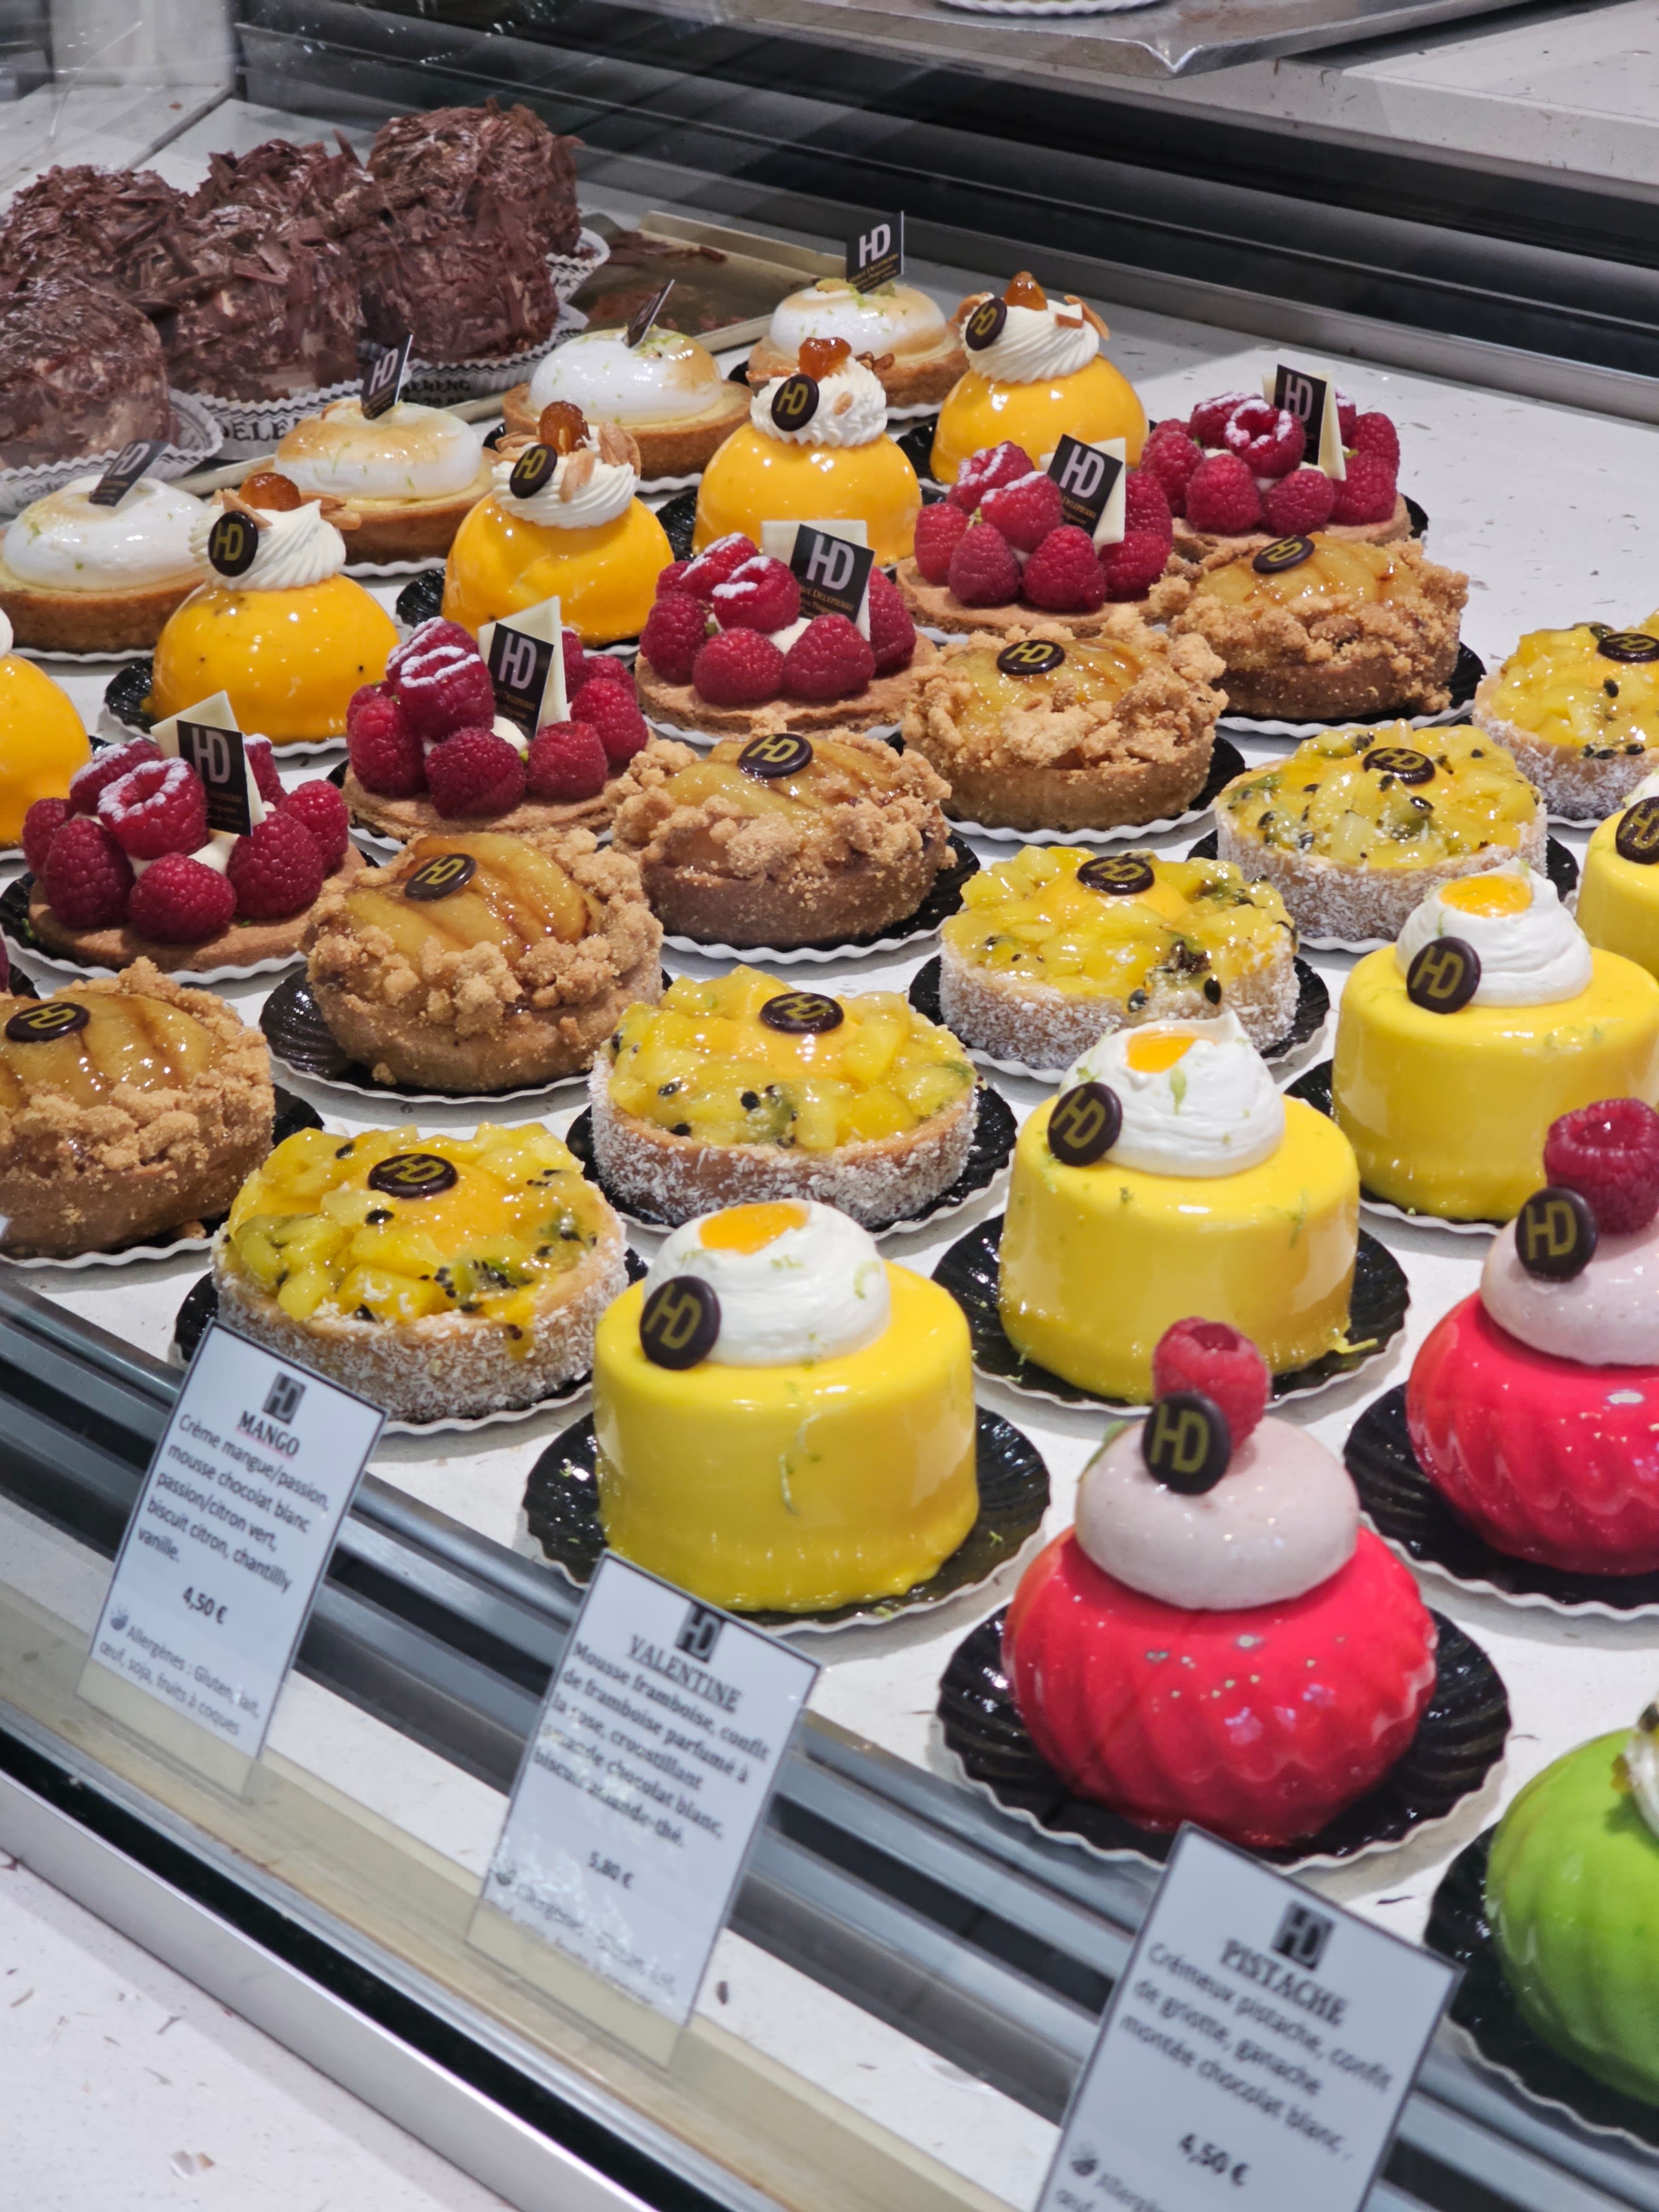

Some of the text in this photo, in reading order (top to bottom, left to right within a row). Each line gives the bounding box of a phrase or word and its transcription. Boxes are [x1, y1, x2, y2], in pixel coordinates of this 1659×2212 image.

[859, 223, 891, 268] HD
[971, 305, 997, 336] HD
[369, 348, 399, 396] HD
[1285, 373, 1313, 422] HD
[775, 384, 808, 415] HD
[514, 449, 546, 479] HD
[1060, 444, 1105, 498] HD
[212, 523, 243, 560] HD
[806, 534, 855, 590] HD
[1261, 542, 1303, 562] HD
[499, 632, 537, 690] HD
[1006, 642, 1053, 664] HD
[1608, 635, 1657, 652] HD
[191, 727, 231, 784] HD
[747, 735, 799, 761] HD
[1372, 749, 1425, 770] HD
[414, 856, 465, 884] HD
[1088, 857, 1146, 881] HD
[1413, 946, 1463, 998] HD
[20, 1004, 76, 1029] HD
[1051, 1088, 1105, 1148] HD
[380, 1156, 445, 1183] HD
[1527, 1202, 1575, 1258] HD
[644, 1284, 700, 1348] HD
[263, 1371, 305, 1425] HD
[239, 1411, 300, 1457] MANGO
[1150, 1404, 1207, 1471] HD
[169, 1444, 311, 1532] mousse chocolat blanc
[179, 1413, 332, 1512] Crème mangue/passion,
[148, 1496, 189, 1531] biscuit
[189, 1521, 232, 1558] citron,
[157, 1469, 279, 1550] passion/citron vert,
[137, 1524, 182, 1561] vanille.
[182, 1586, 227, 1624] 4,50 €
[676, 1603, 724, 1663] HD
[628, 1635, 740, 1712] VALENTINE
[552, 1692, 568, 1713] la
[563, 1666, 750, 1784] de framboise parfumé à
[573, 1641, 770, 1761] Mousse framboise, confit
[607, 1756, 674, 1807] chocolat
[621, 1870, 633, 1890] €
[1272, 1901, 1334, 1970] HD
[1219, 1938, 1349, 2026] PISTACHE
[1133, 1978, 1161, 2004] de
[1234, 2037, 1323, 2097] ganache
[1195, 2056, 1286, 2117] chocolat
[1176, 2131, 1251, 2187] 4,50 €
